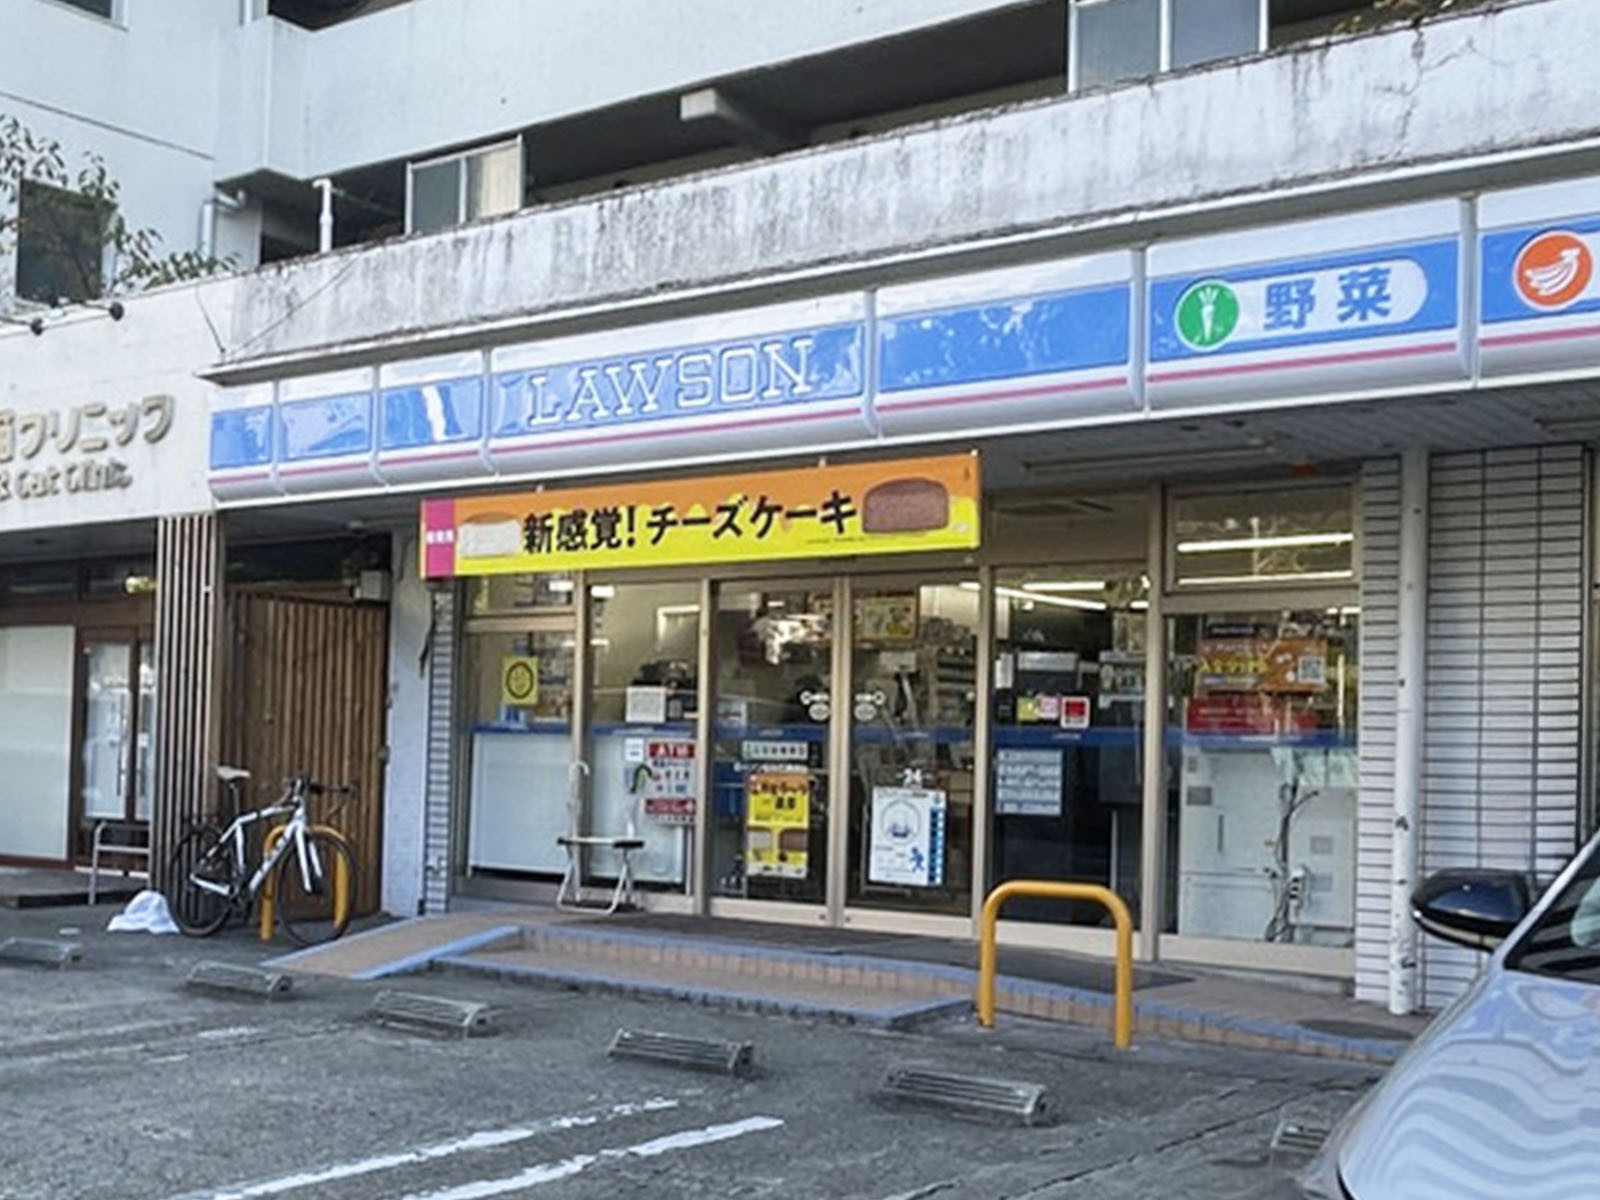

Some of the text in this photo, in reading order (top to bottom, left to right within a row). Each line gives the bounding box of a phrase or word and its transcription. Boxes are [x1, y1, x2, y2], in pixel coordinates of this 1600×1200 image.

[1263, 267, 1393, 331] 野菜
[528, 335, 815, 427] LAWSON
[656, 743, 689, 758] ATM
